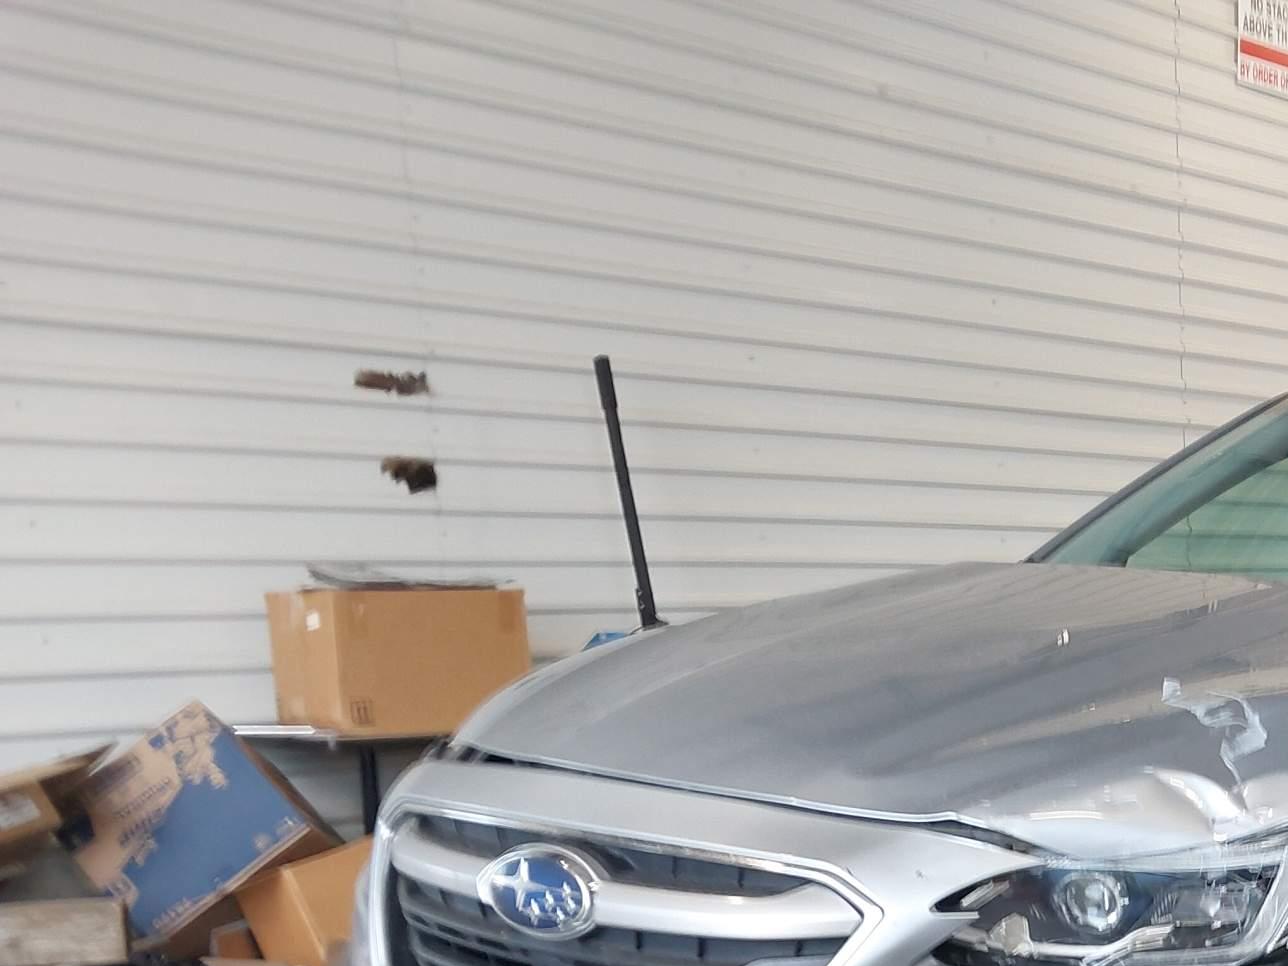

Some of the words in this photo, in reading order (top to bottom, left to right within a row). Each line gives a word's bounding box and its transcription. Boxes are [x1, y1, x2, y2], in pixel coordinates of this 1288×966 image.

[1250, 0, 1264, 14] NO
[1242, 14, 1273, 39] ABOVE
[1240, 62, 1249, 79] BY
[1253, 63, 1278, 87] ORDER
